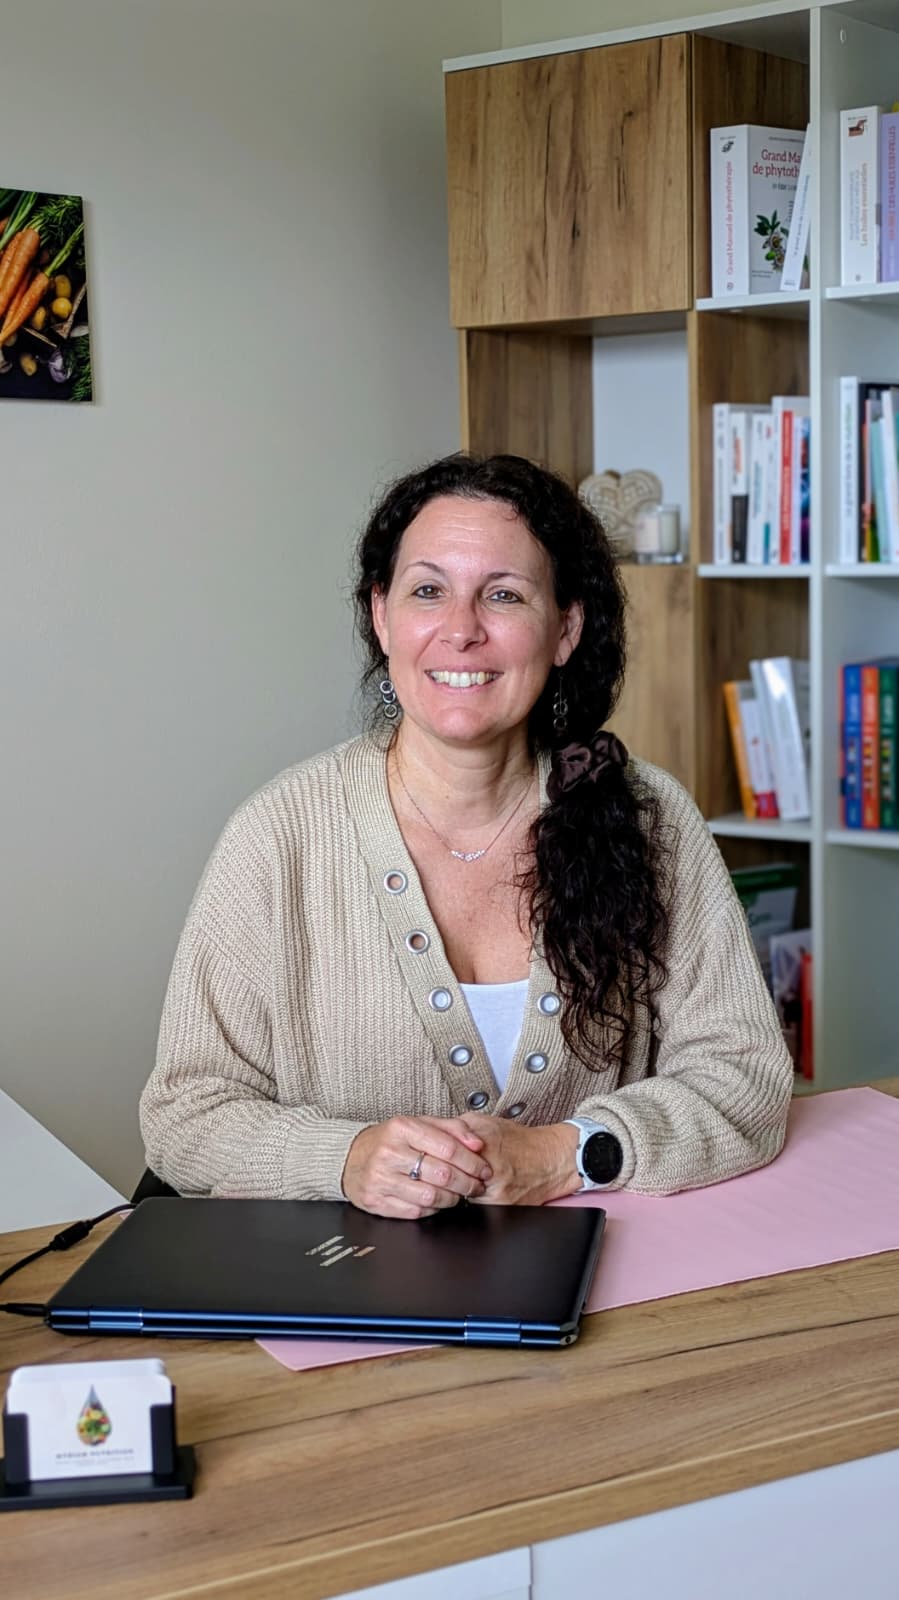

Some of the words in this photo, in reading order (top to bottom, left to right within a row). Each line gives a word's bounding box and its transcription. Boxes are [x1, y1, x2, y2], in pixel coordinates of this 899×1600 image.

[761, 148, 787, 162] Grand
[788, 151, 801, 163] Ma
[752, 161, 764, 175] de
